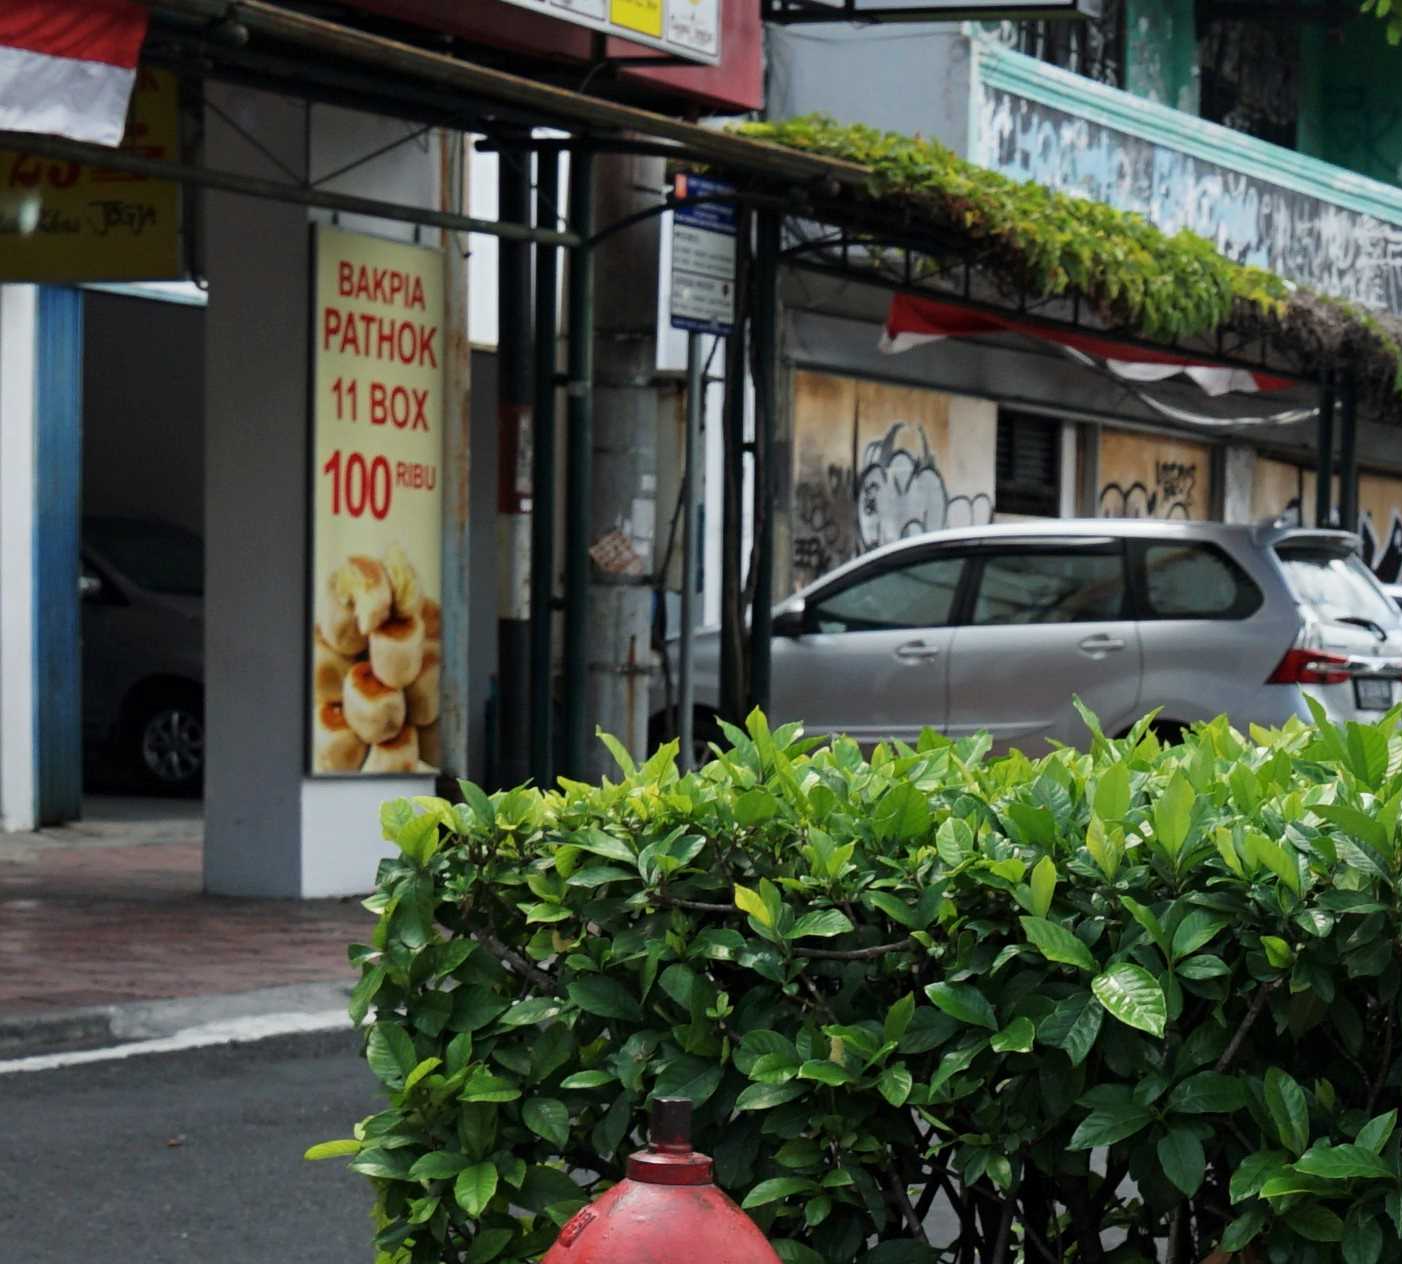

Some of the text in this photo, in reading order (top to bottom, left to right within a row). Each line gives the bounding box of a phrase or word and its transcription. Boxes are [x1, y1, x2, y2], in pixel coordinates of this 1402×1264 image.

[337, 261, 426, 311] BAKPIA
[324, 307, 438, 369] PATHOK
[331, 377, 429, 432] 11 BOX
[323, 450, 437, 520] 100 RIBU
